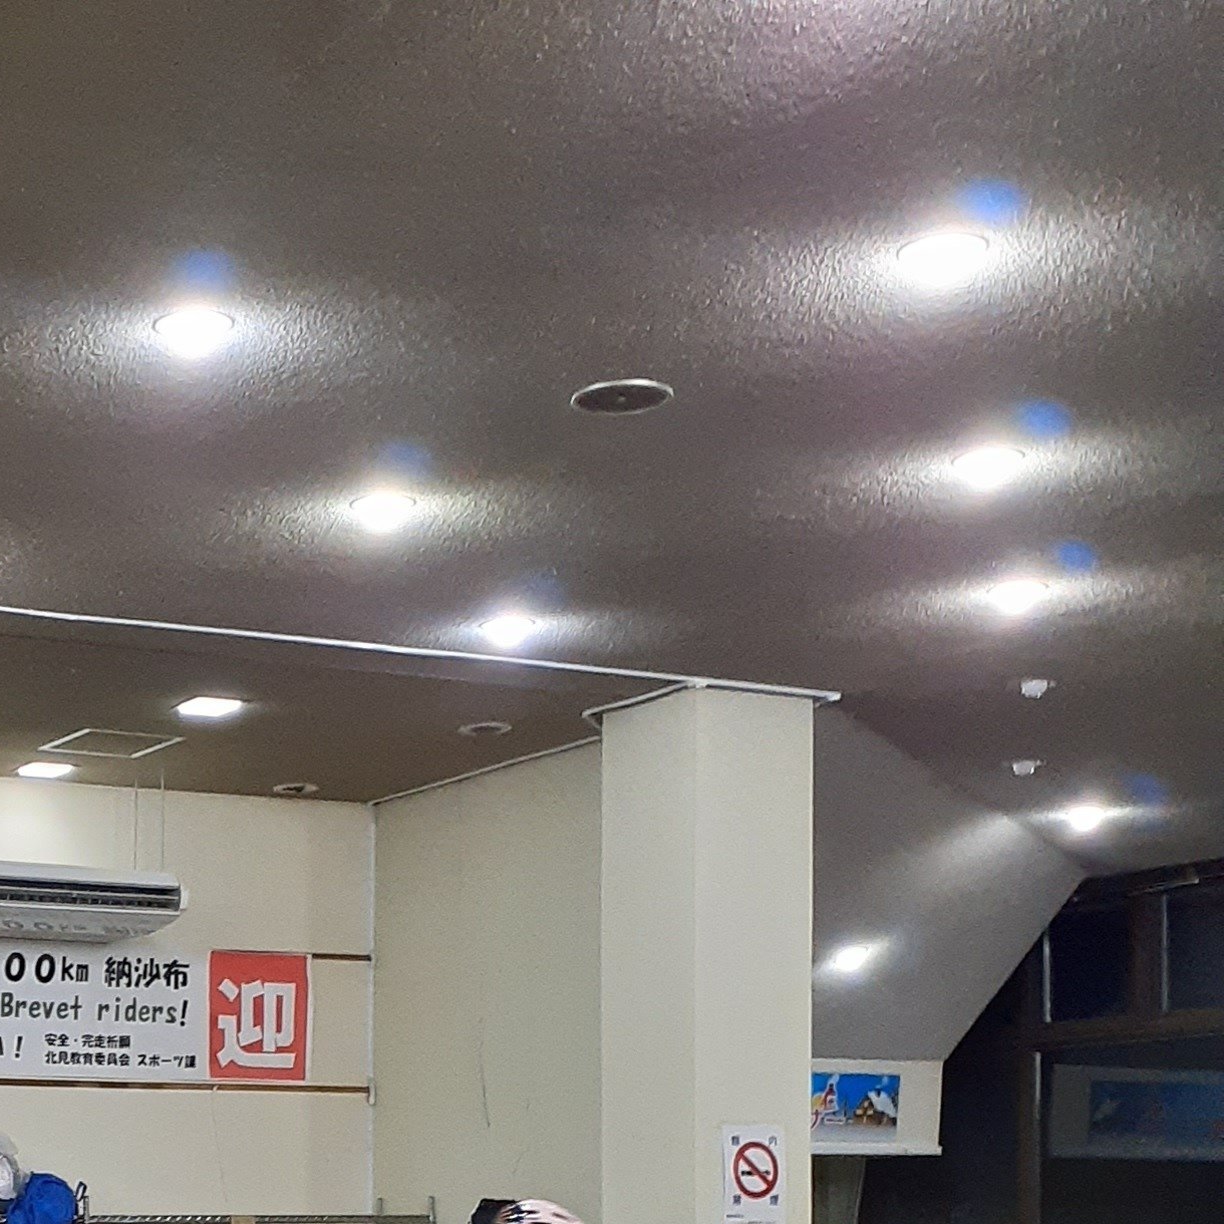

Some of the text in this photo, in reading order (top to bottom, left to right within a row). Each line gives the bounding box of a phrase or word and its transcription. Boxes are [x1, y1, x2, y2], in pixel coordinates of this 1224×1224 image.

[100, 956, 190, 990] 納沙布
[0, 991, 83, 1021] Brevet
[97, 997, 188, 1027] riders!
[216, 978, 297, 1068] 迎
[44, 1050, 197, 1069] 北見教育委員会 スポーツ課
